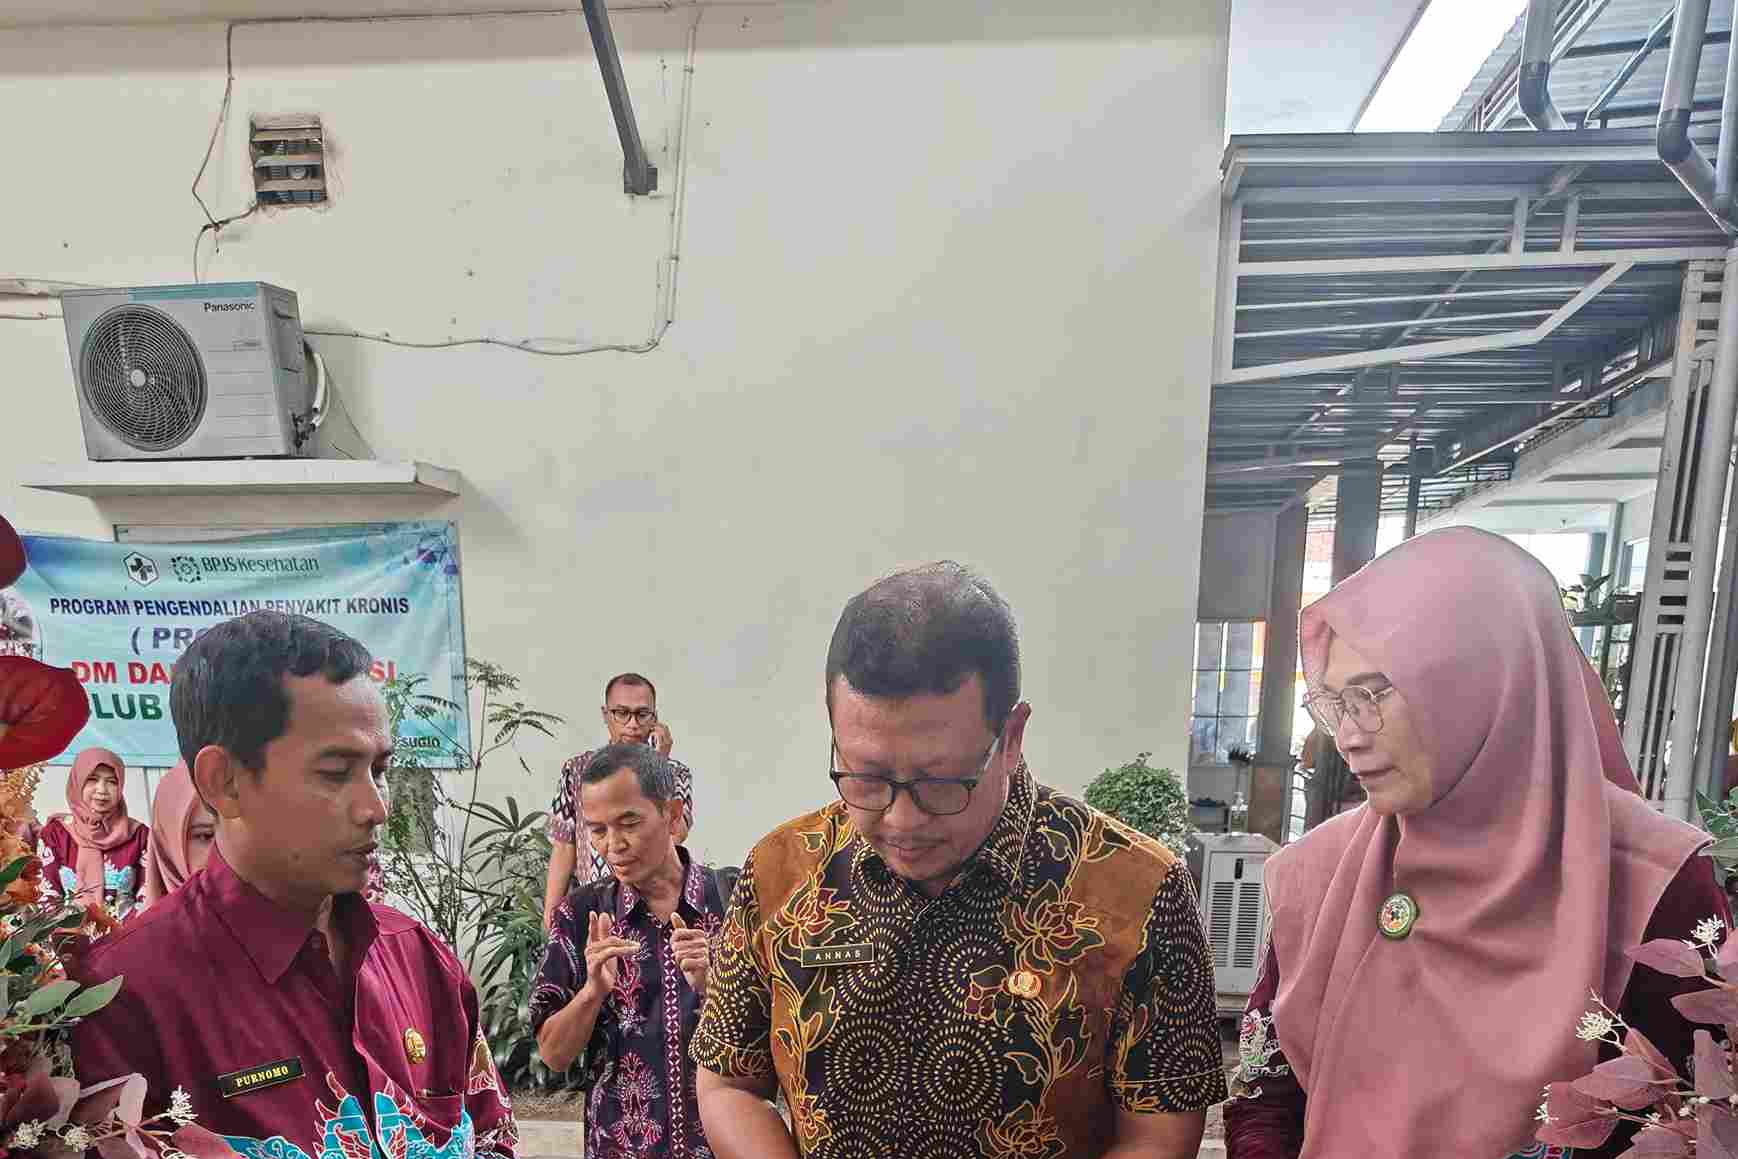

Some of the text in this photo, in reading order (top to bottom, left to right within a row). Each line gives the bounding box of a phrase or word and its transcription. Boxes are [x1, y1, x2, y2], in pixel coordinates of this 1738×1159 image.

[203, 302, 256, 313] Panasonic
[50, 598, 409, 617] PROGRAM PENGENDALIAN PENYAKIT KRONIS
[152, 627, 206, 650] PR
[72, 661, 117, 684] DM
[127, 661, 177, 685] DA
[91, 693, 163, 720] LUB
[815, 950, 861, 961] ANNAS
[235, 1065, 289, 1087] PURNOMO
